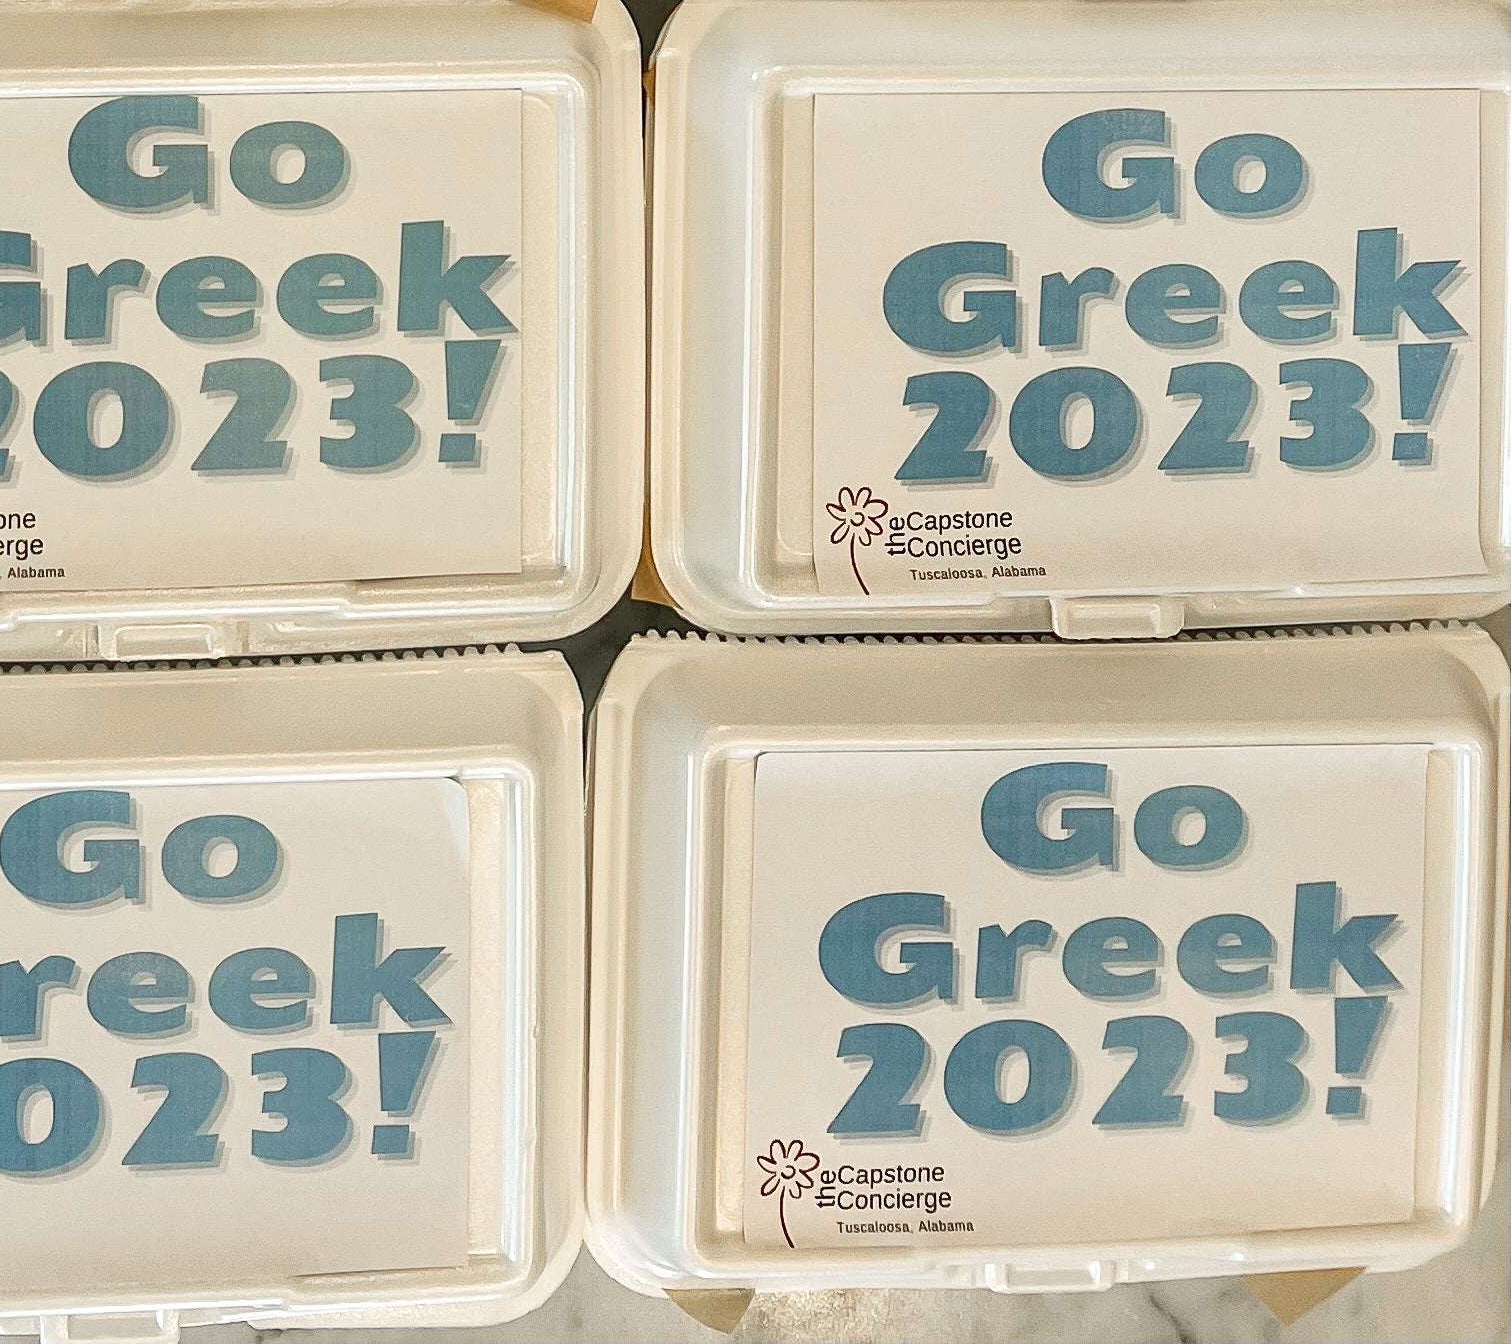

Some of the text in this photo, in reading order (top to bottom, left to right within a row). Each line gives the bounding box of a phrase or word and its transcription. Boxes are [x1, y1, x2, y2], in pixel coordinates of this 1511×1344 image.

[70, 92, 351, 213] Go
[1042, 108, 1309, 224] Go
[883, 227, 1468, 358] Greek
[894, 342, 1458, 482] 2023!
[883, 516, 907, 557] the
[906, 510, 1013, 536] Capstone
[907, 533, 1022, 561] Concierge
[7, 565, 66, 579] Alabama
[991, 564, 1047, 578] Alabama
[981, 762, 1249, 876] Go
[818, 881, 1404, 1010] Greek
[827, 995, 1392, 1138] 2023!
[813, 1169, 837, 1209] the
[837, 1164, 945, 1192] Capstone
[836, 1187, 952, 1215] Concierge
[918, 1219, 975, 1233] Alabama
